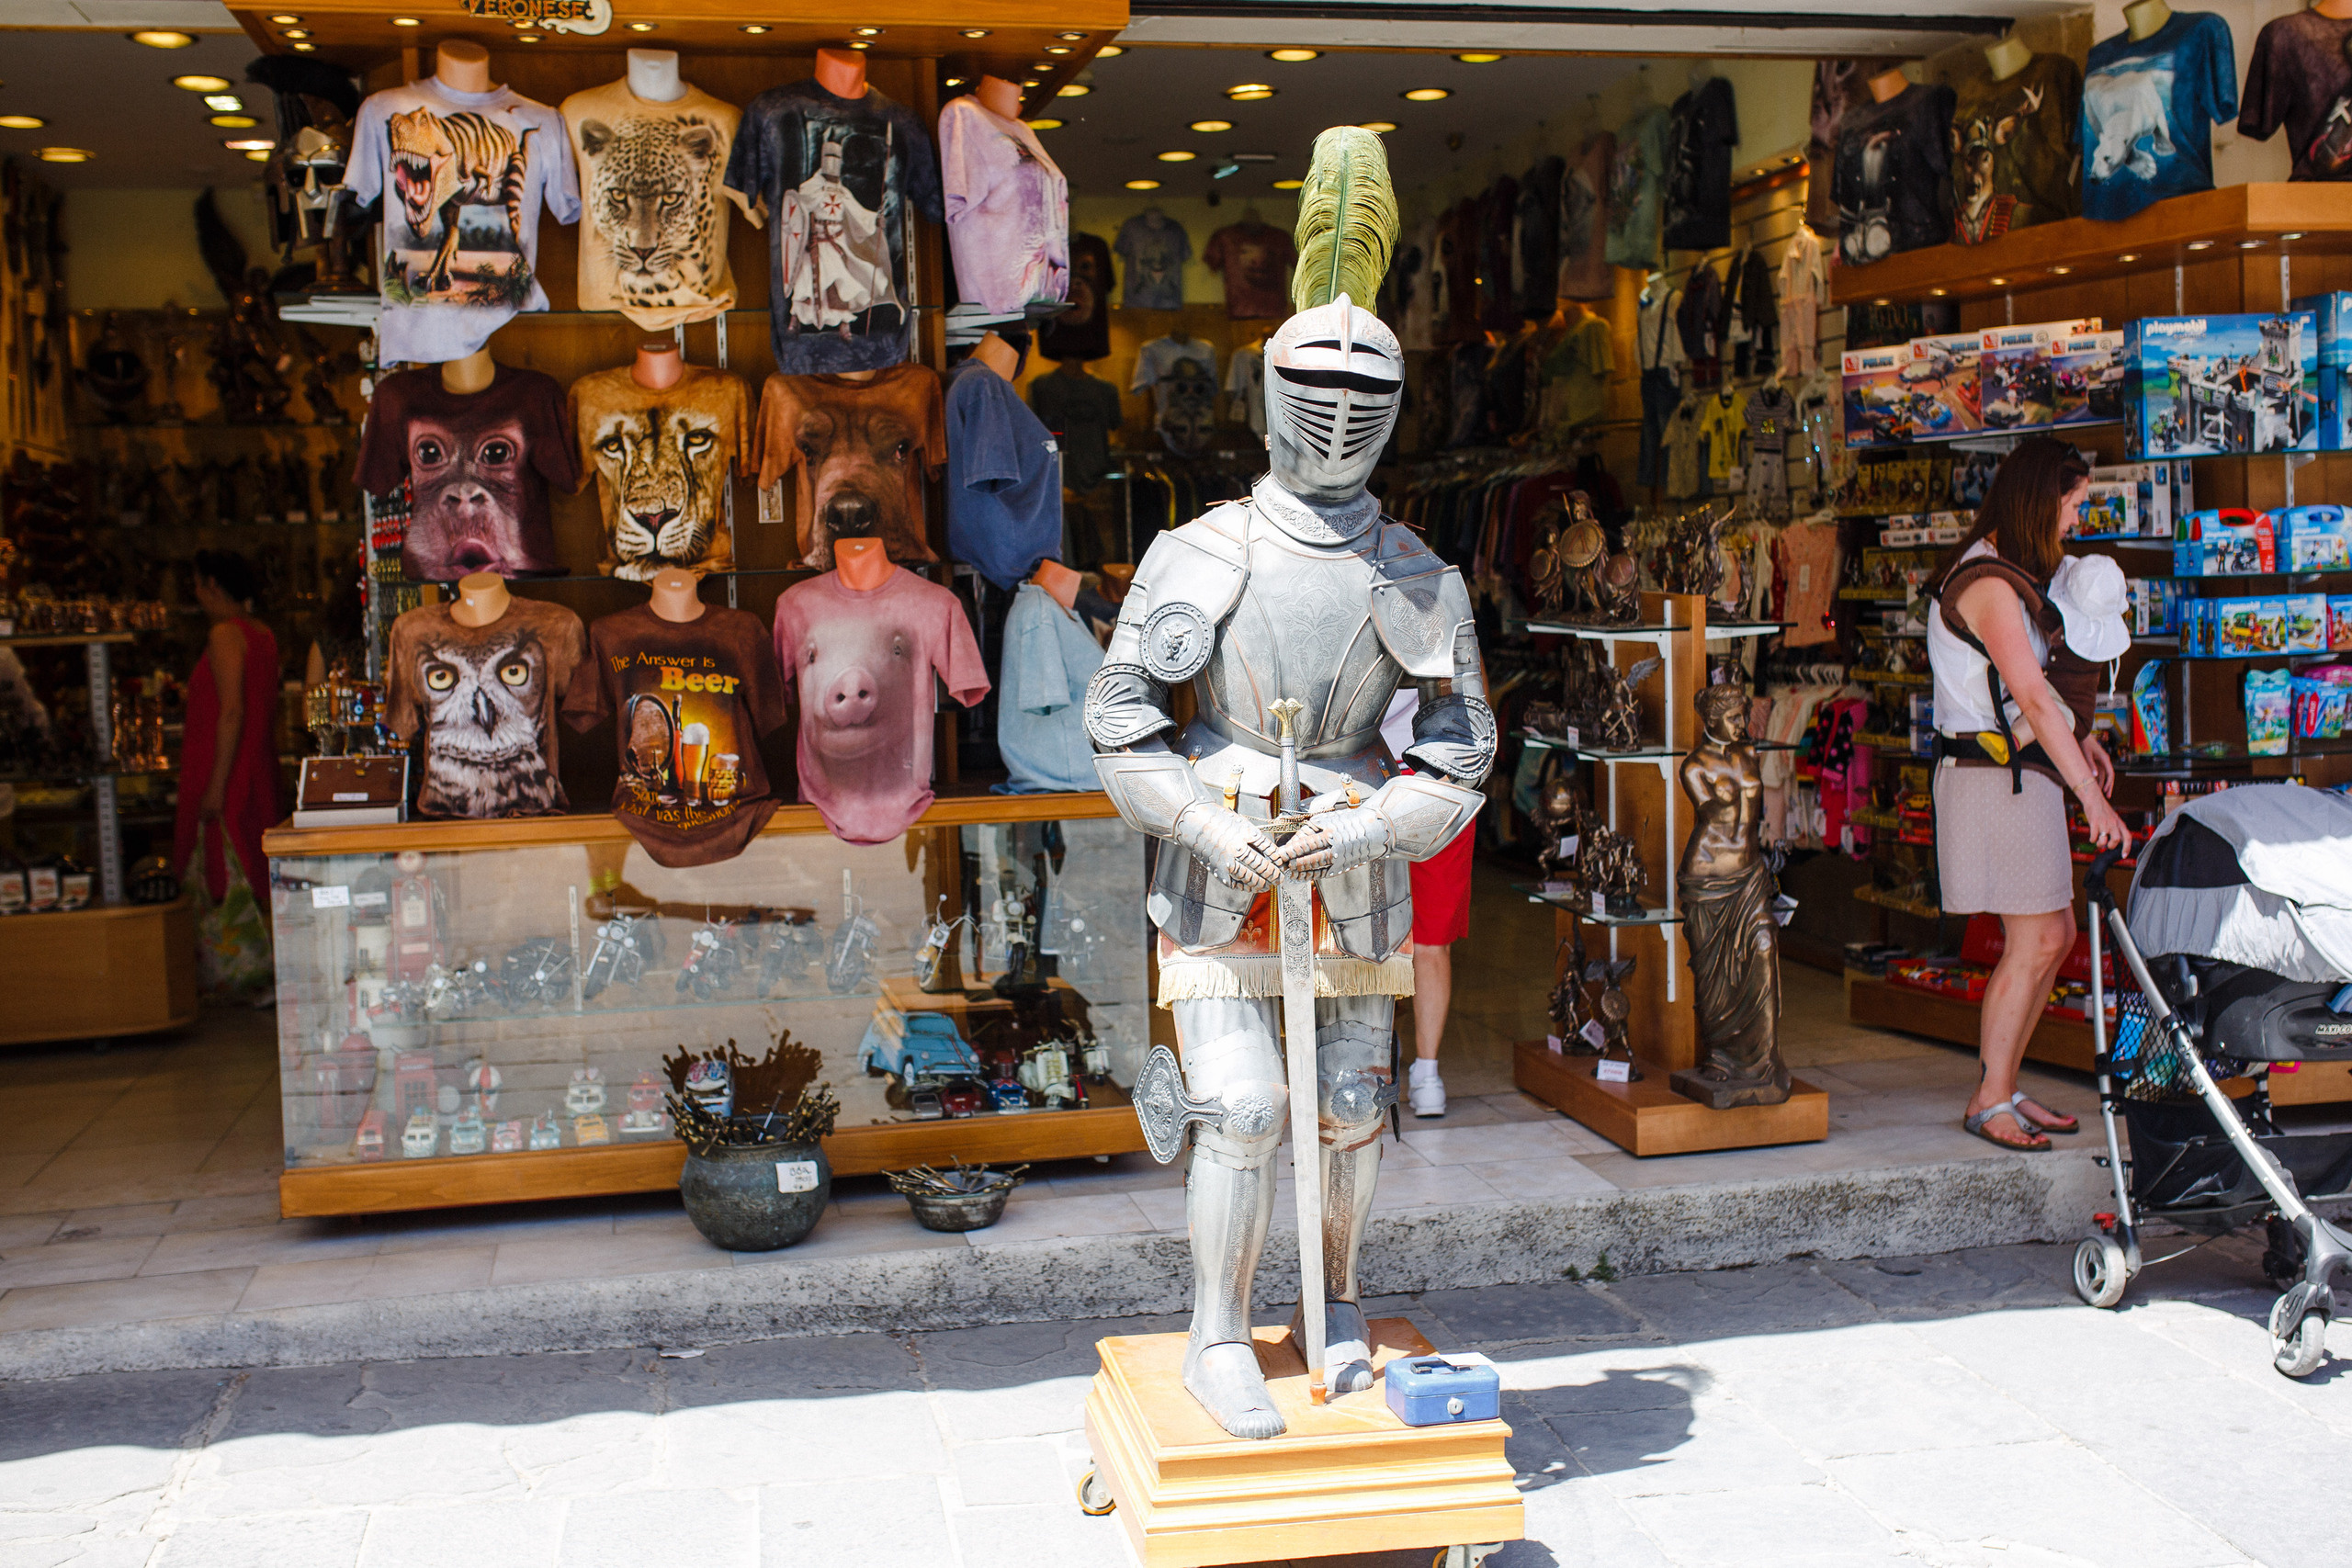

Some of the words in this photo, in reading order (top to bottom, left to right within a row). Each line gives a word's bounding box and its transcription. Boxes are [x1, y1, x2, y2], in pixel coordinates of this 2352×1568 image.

[469, 0, 585, 20] VERONESE
[2145, 318, 2207, 337] playmobil
[610, 655, 629, 673] The
[637, 651, 696, 667] Answer
[660, 666, 740, 694] Beer
